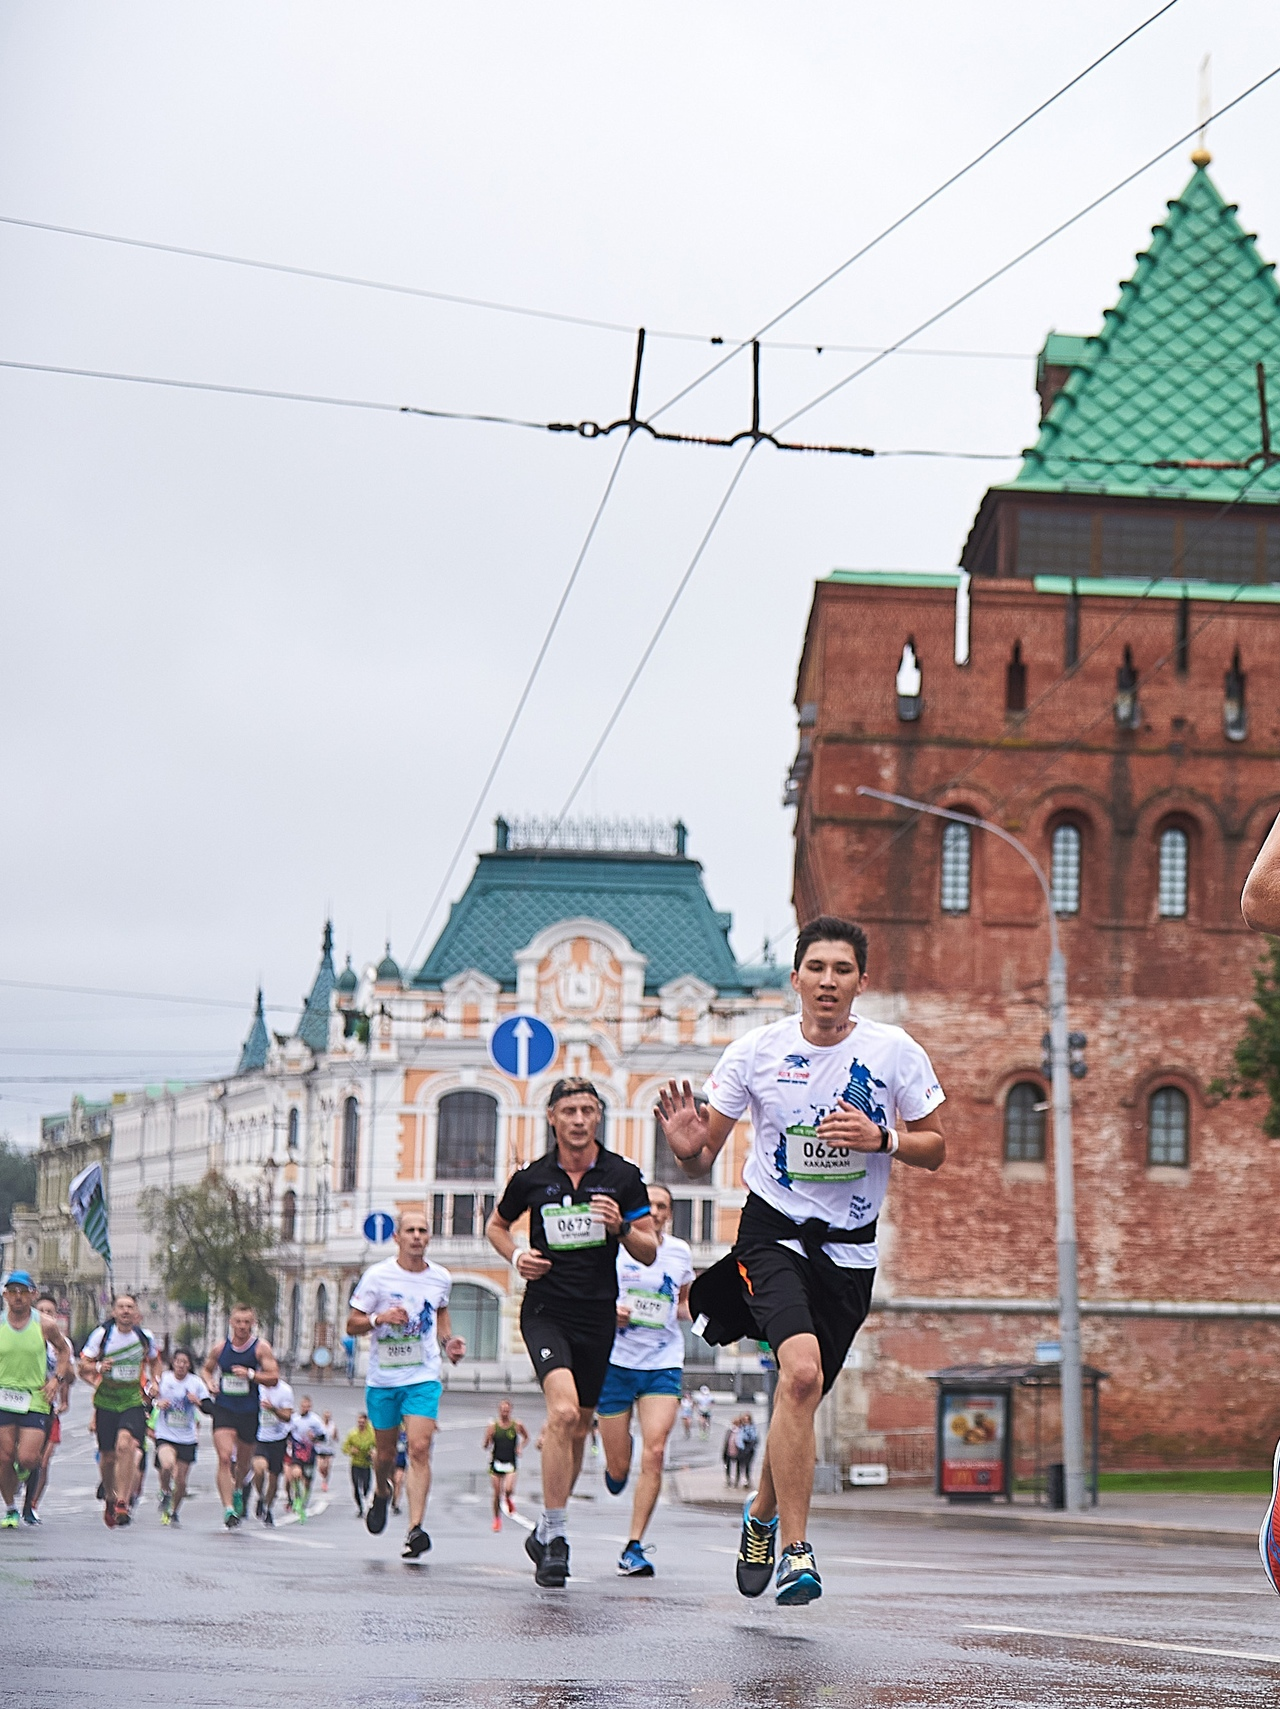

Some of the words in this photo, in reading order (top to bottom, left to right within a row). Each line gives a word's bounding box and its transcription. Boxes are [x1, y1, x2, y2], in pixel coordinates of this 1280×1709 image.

[803, 1142, 850, 1158] 0620
[803, 1160, 851, 1169] КАКАДЖАН
[557, 1217, 592, 1232] 0679
